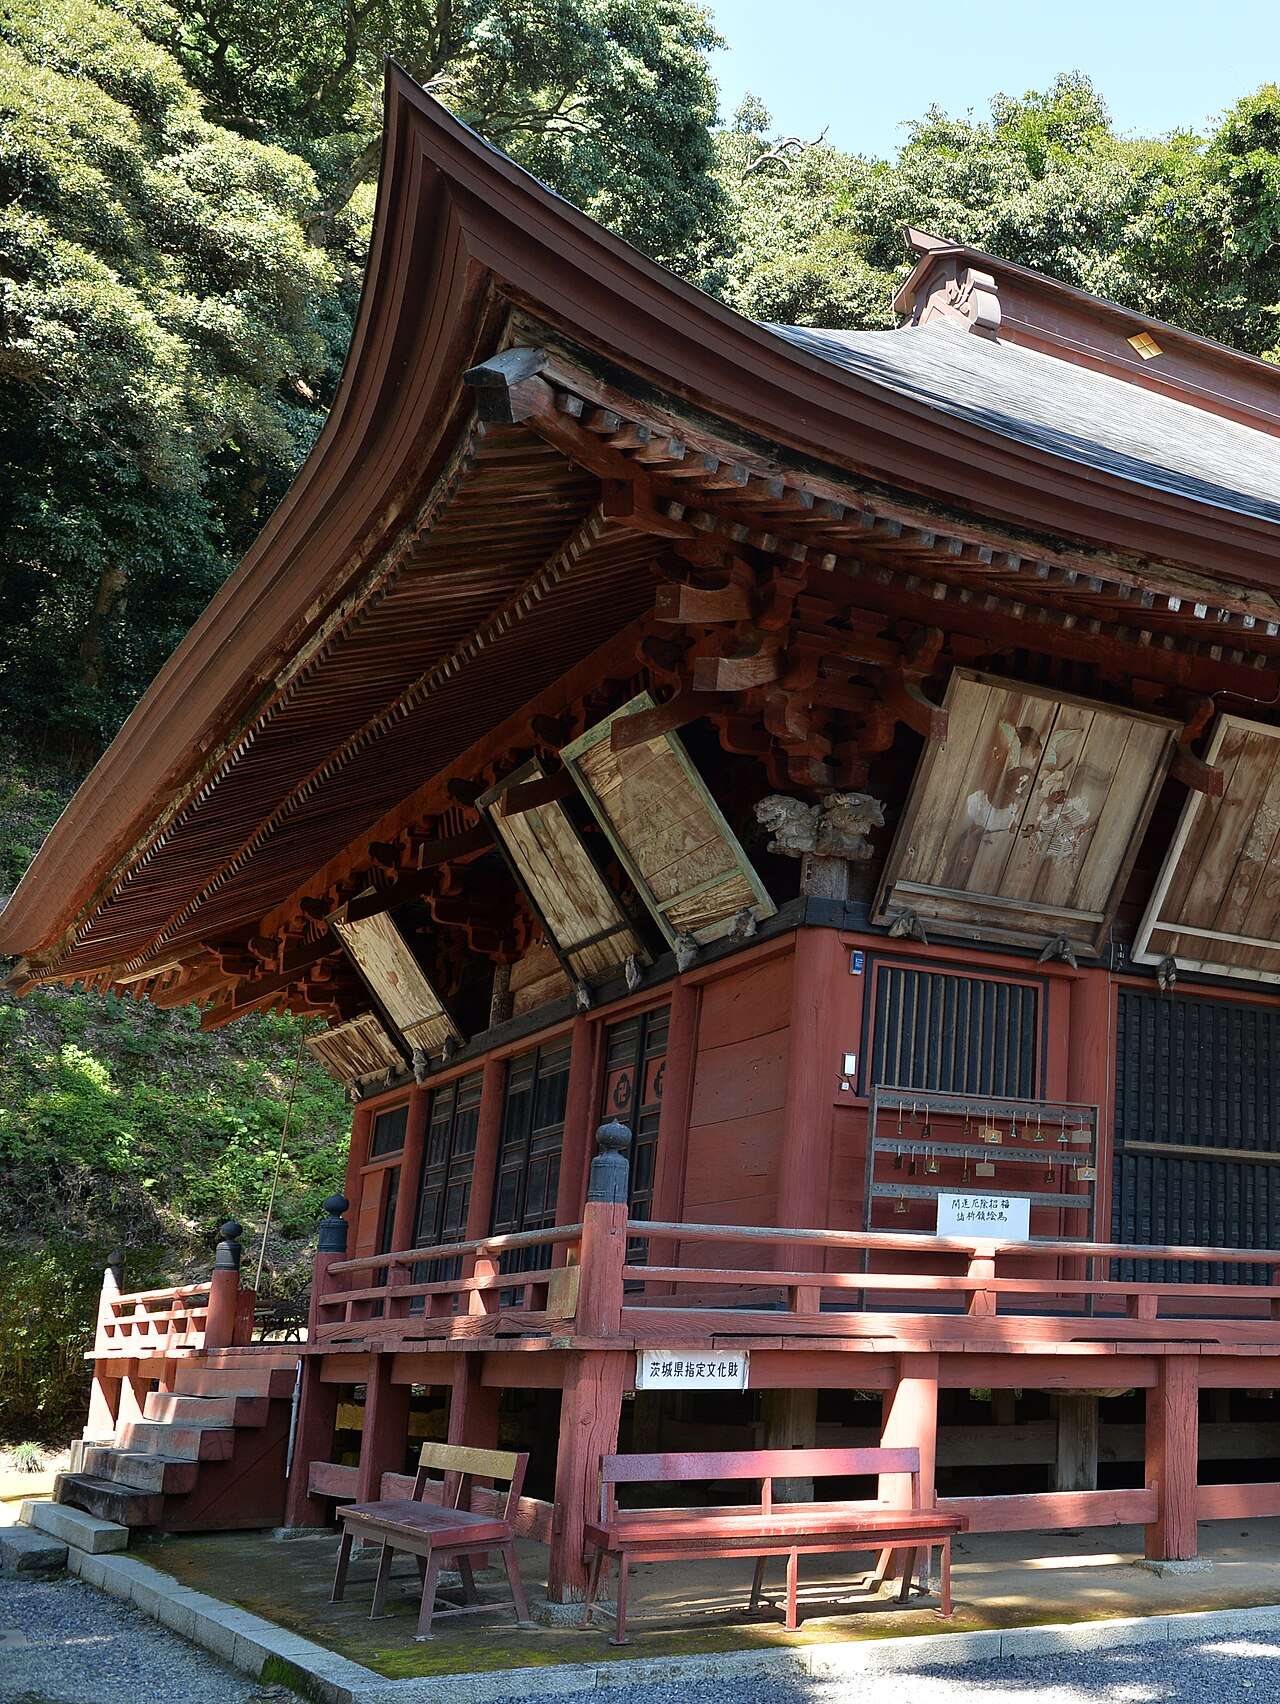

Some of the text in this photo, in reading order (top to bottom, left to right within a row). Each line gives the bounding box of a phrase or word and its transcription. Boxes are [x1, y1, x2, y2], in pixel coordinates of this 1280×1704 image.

[649, 1361, 739, 1378] 茨城県指定文化財
